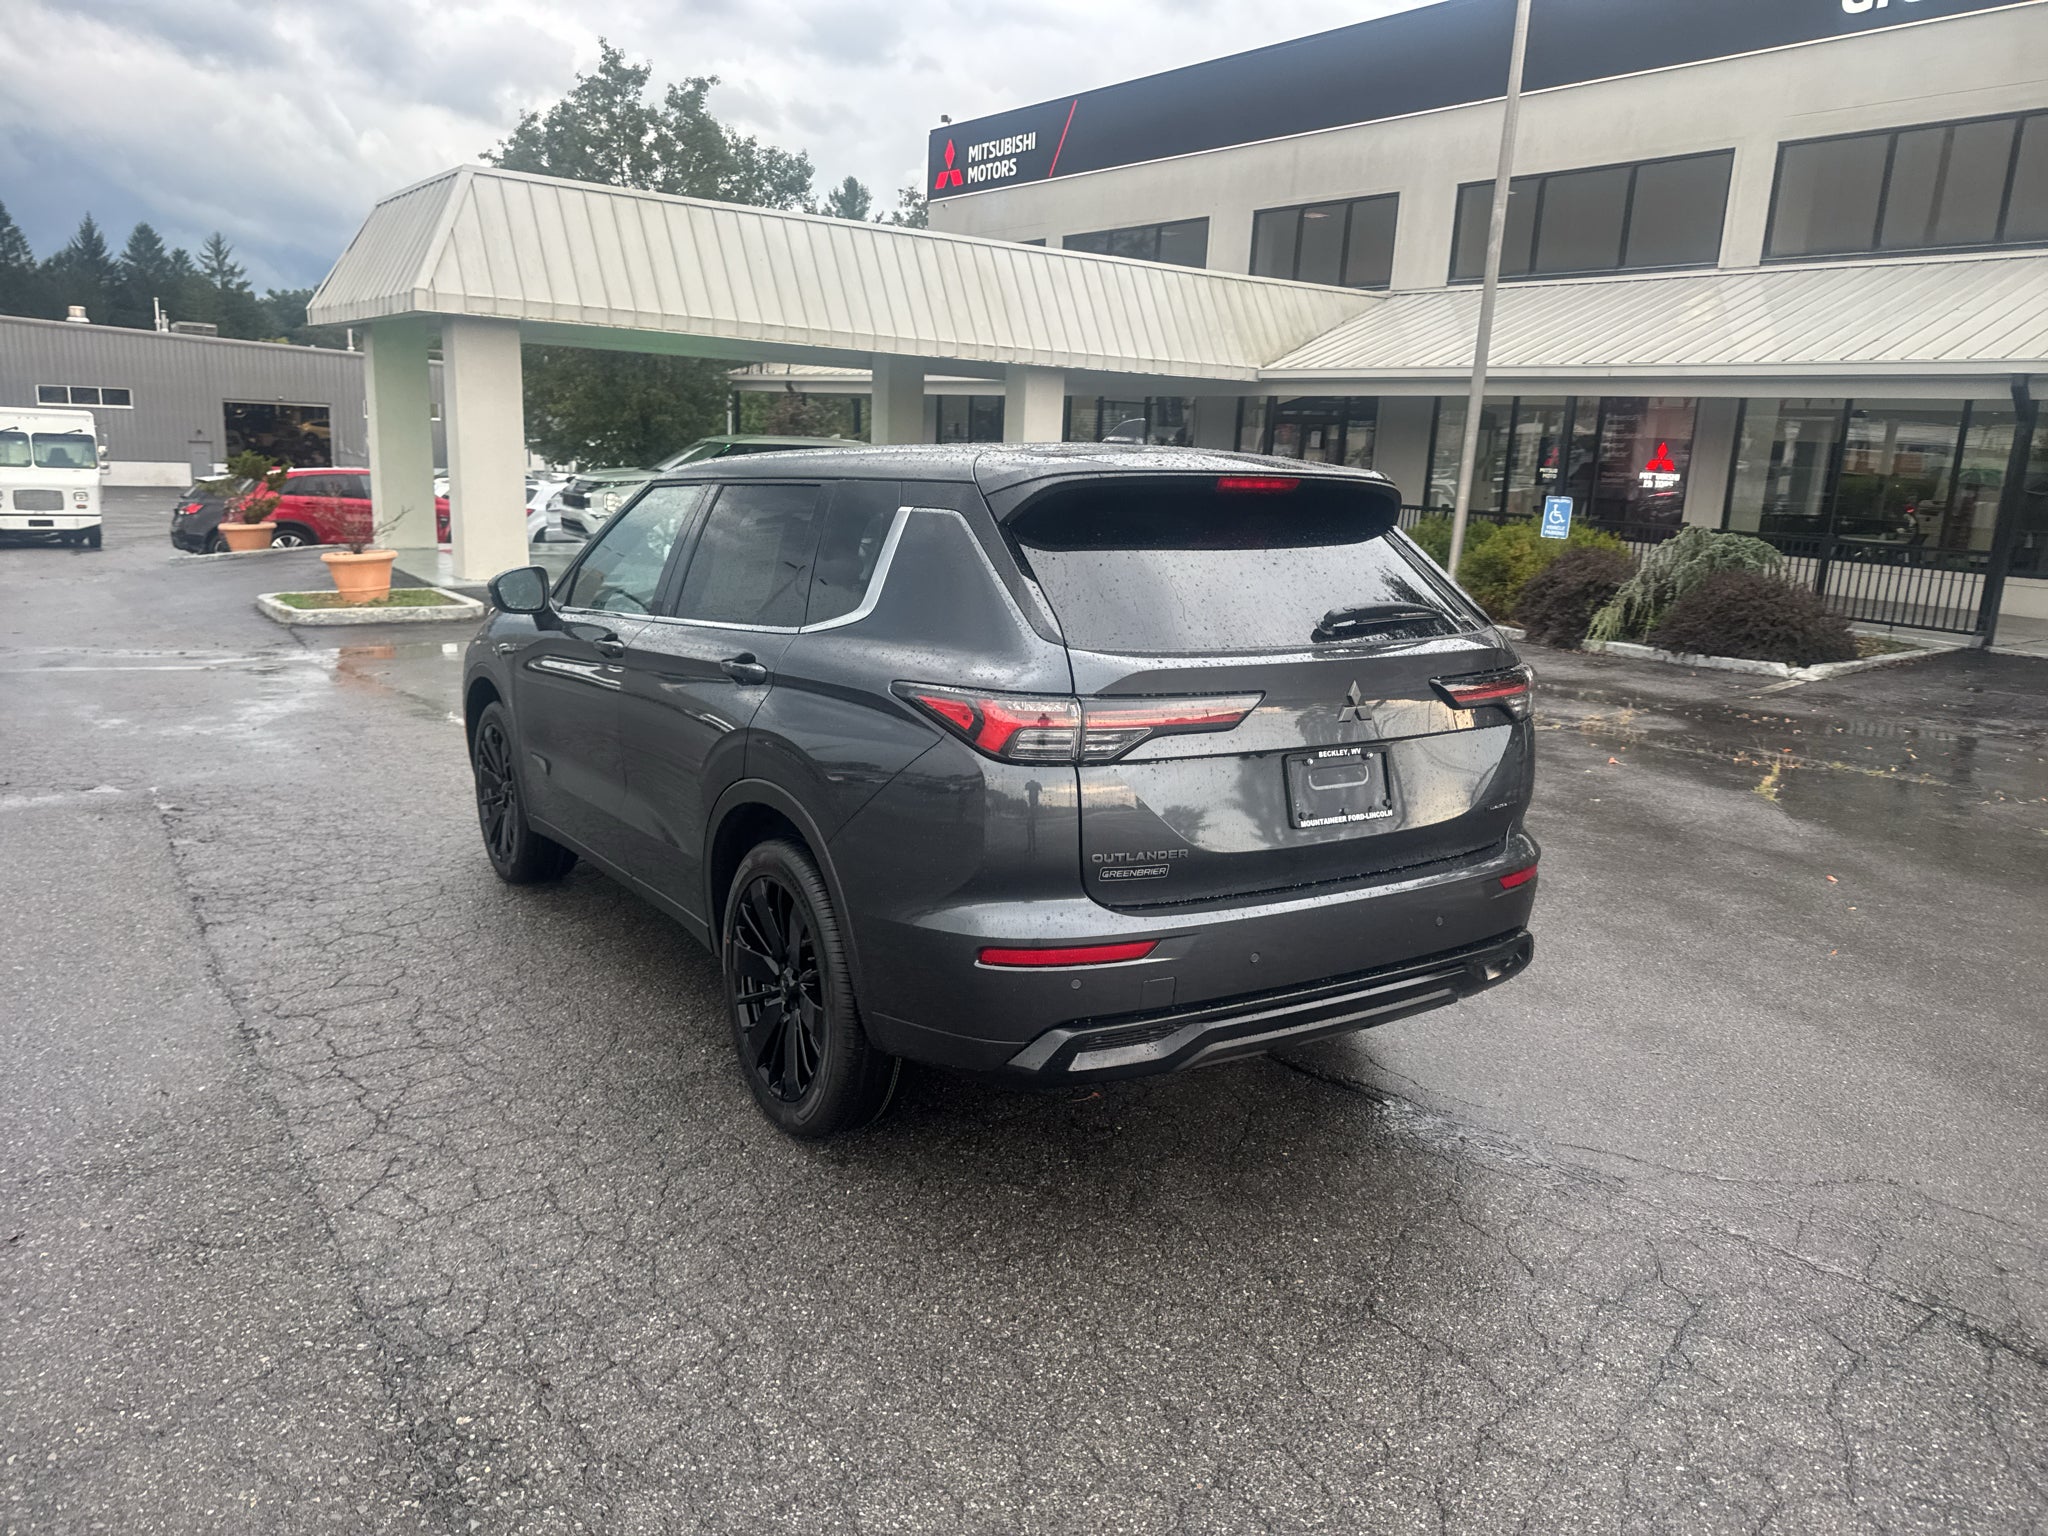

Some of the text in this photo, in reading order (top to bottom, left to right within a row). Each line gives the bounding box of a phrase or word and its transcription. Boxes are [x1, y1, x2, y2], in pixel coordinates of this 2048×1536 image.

[968, 132, 1036, 163] MITSUBISHI
[967, 158, 1017, 184] MOTORS
[1639, 472, 1680, 481] MITUBISHI
[1318, 747, 1361, 758] BECKLEY, WV
[1300, 809, 1393, 828] MOUNTAINEER FORD-LINCOLN
[1091, 848, 1189, 863] OUTLANDER
[1101, 867, 1166, 879] GREENBRIER
